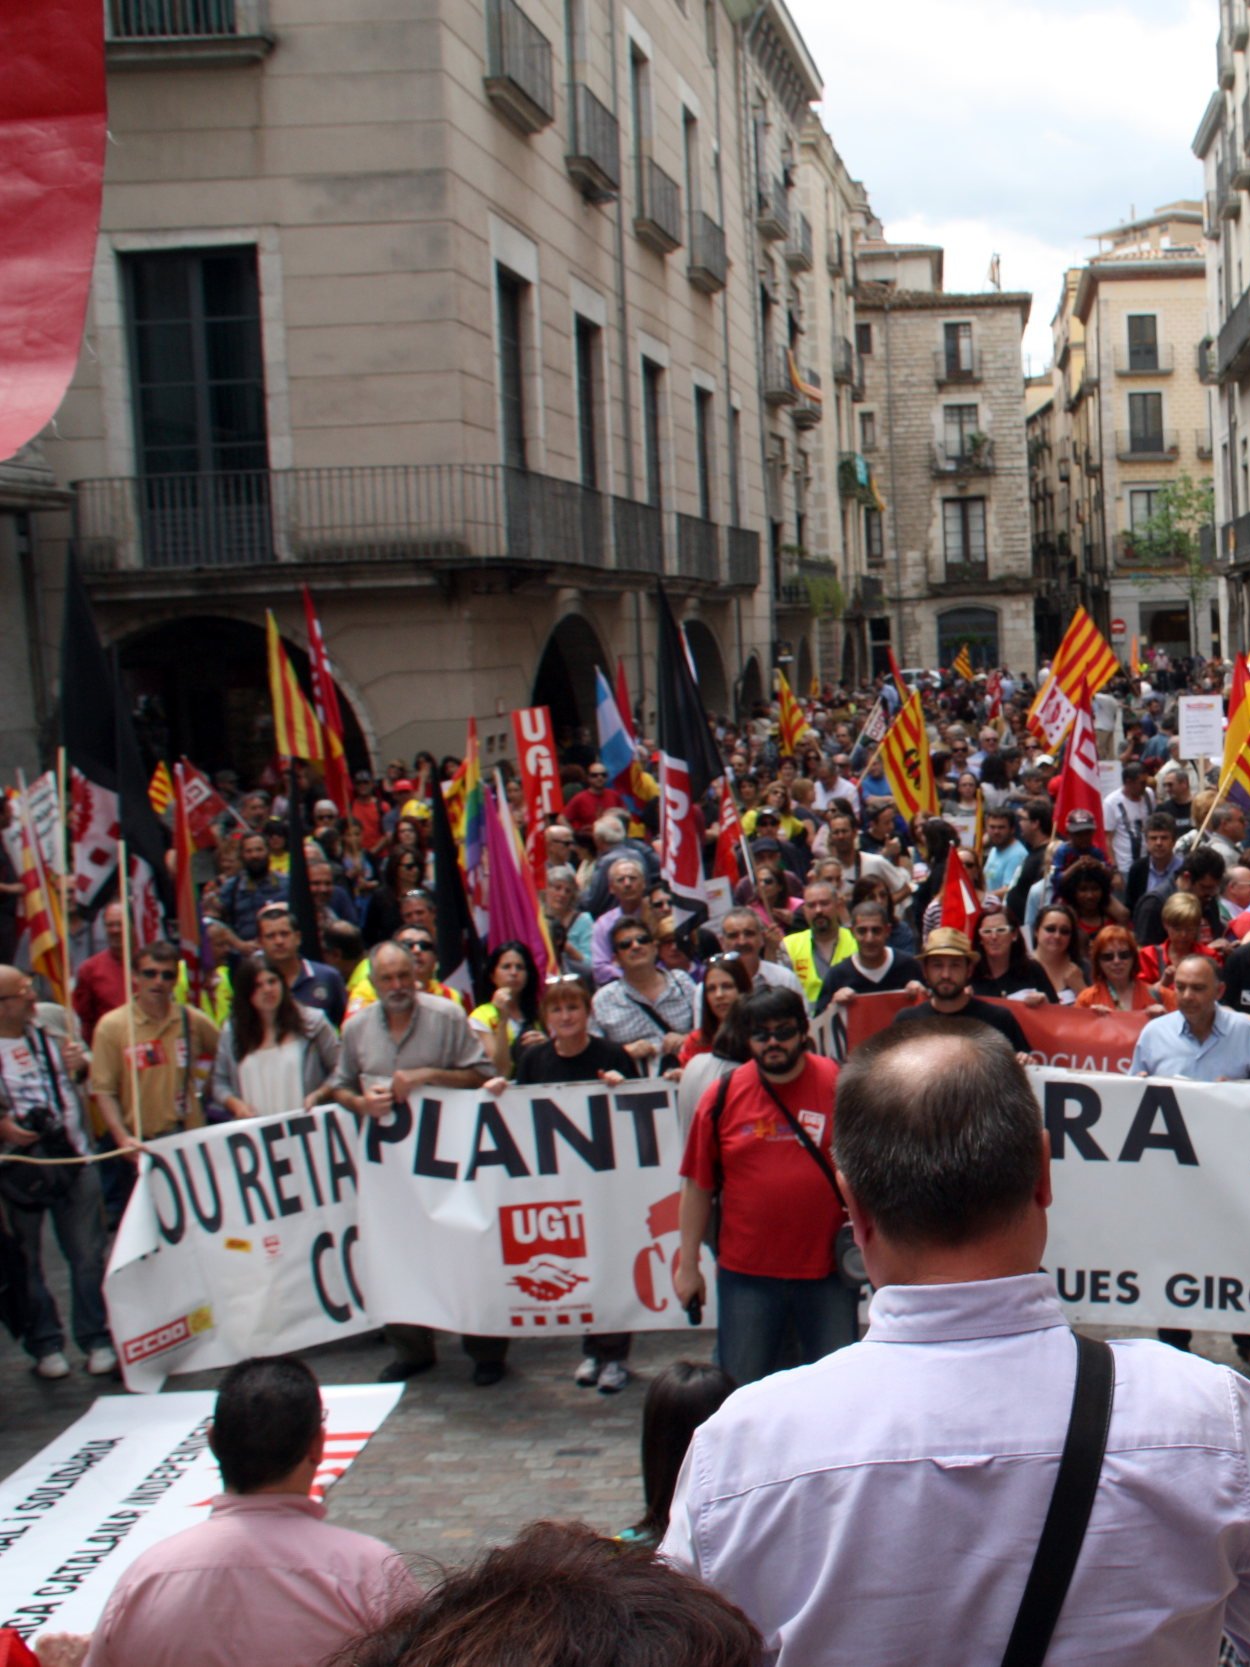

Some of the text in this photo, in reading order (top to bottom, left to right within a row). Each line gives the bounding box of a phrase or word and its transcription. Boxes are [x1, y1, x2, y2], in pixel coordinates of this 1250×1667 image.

[366, 1091, 680, 1182] PLANT
[225, 1108, 361, 1225] RETA
[511, 1206, 583, 1245] UGT
[1040, 1266, 1139, 1305] UES
[127, 1324, 187, 1357] CCOO
